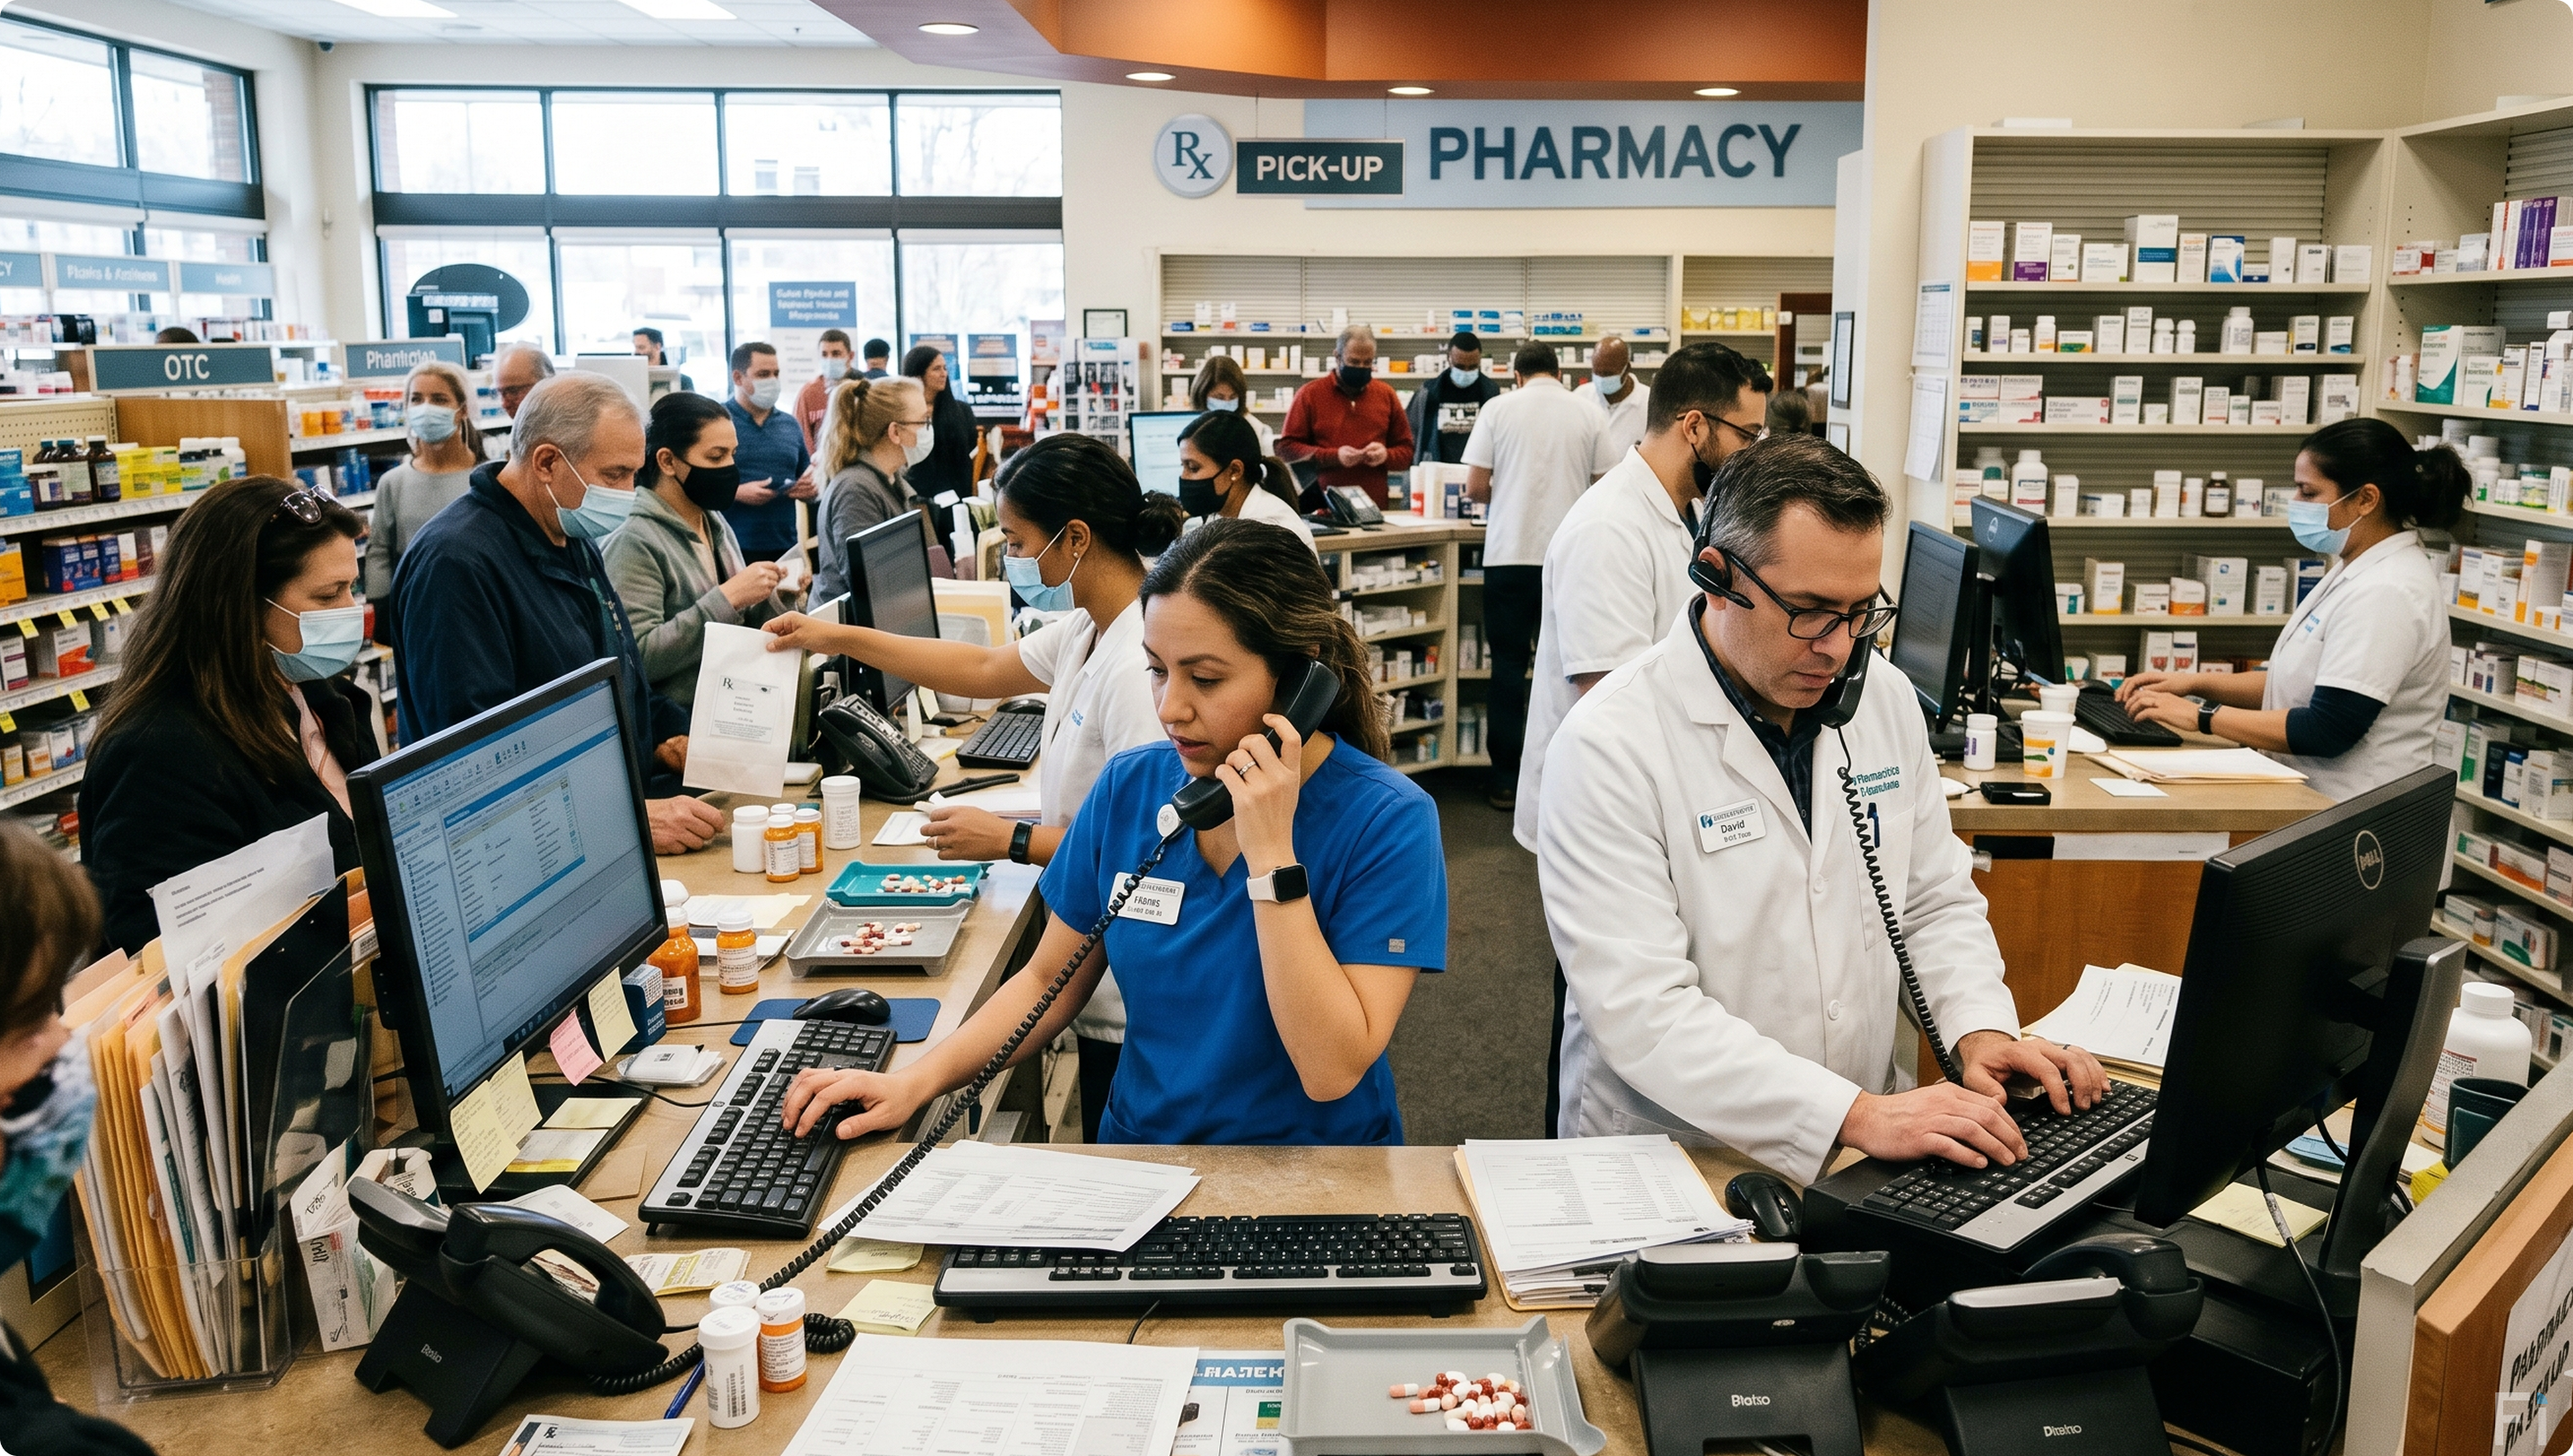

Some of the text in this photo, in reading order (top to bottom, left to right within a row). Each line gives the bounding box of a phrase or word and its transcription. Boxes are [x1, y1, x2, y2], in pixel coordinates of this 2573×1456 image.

[1171, 131, 1215, 179] Rx
[1430, 124, 1803, 180] PHARMACY
[1256, 155, 1384, 181] PICK-UP
[164, 353, 210, 381] OTC
[1720, 819, 1746, 834] David
